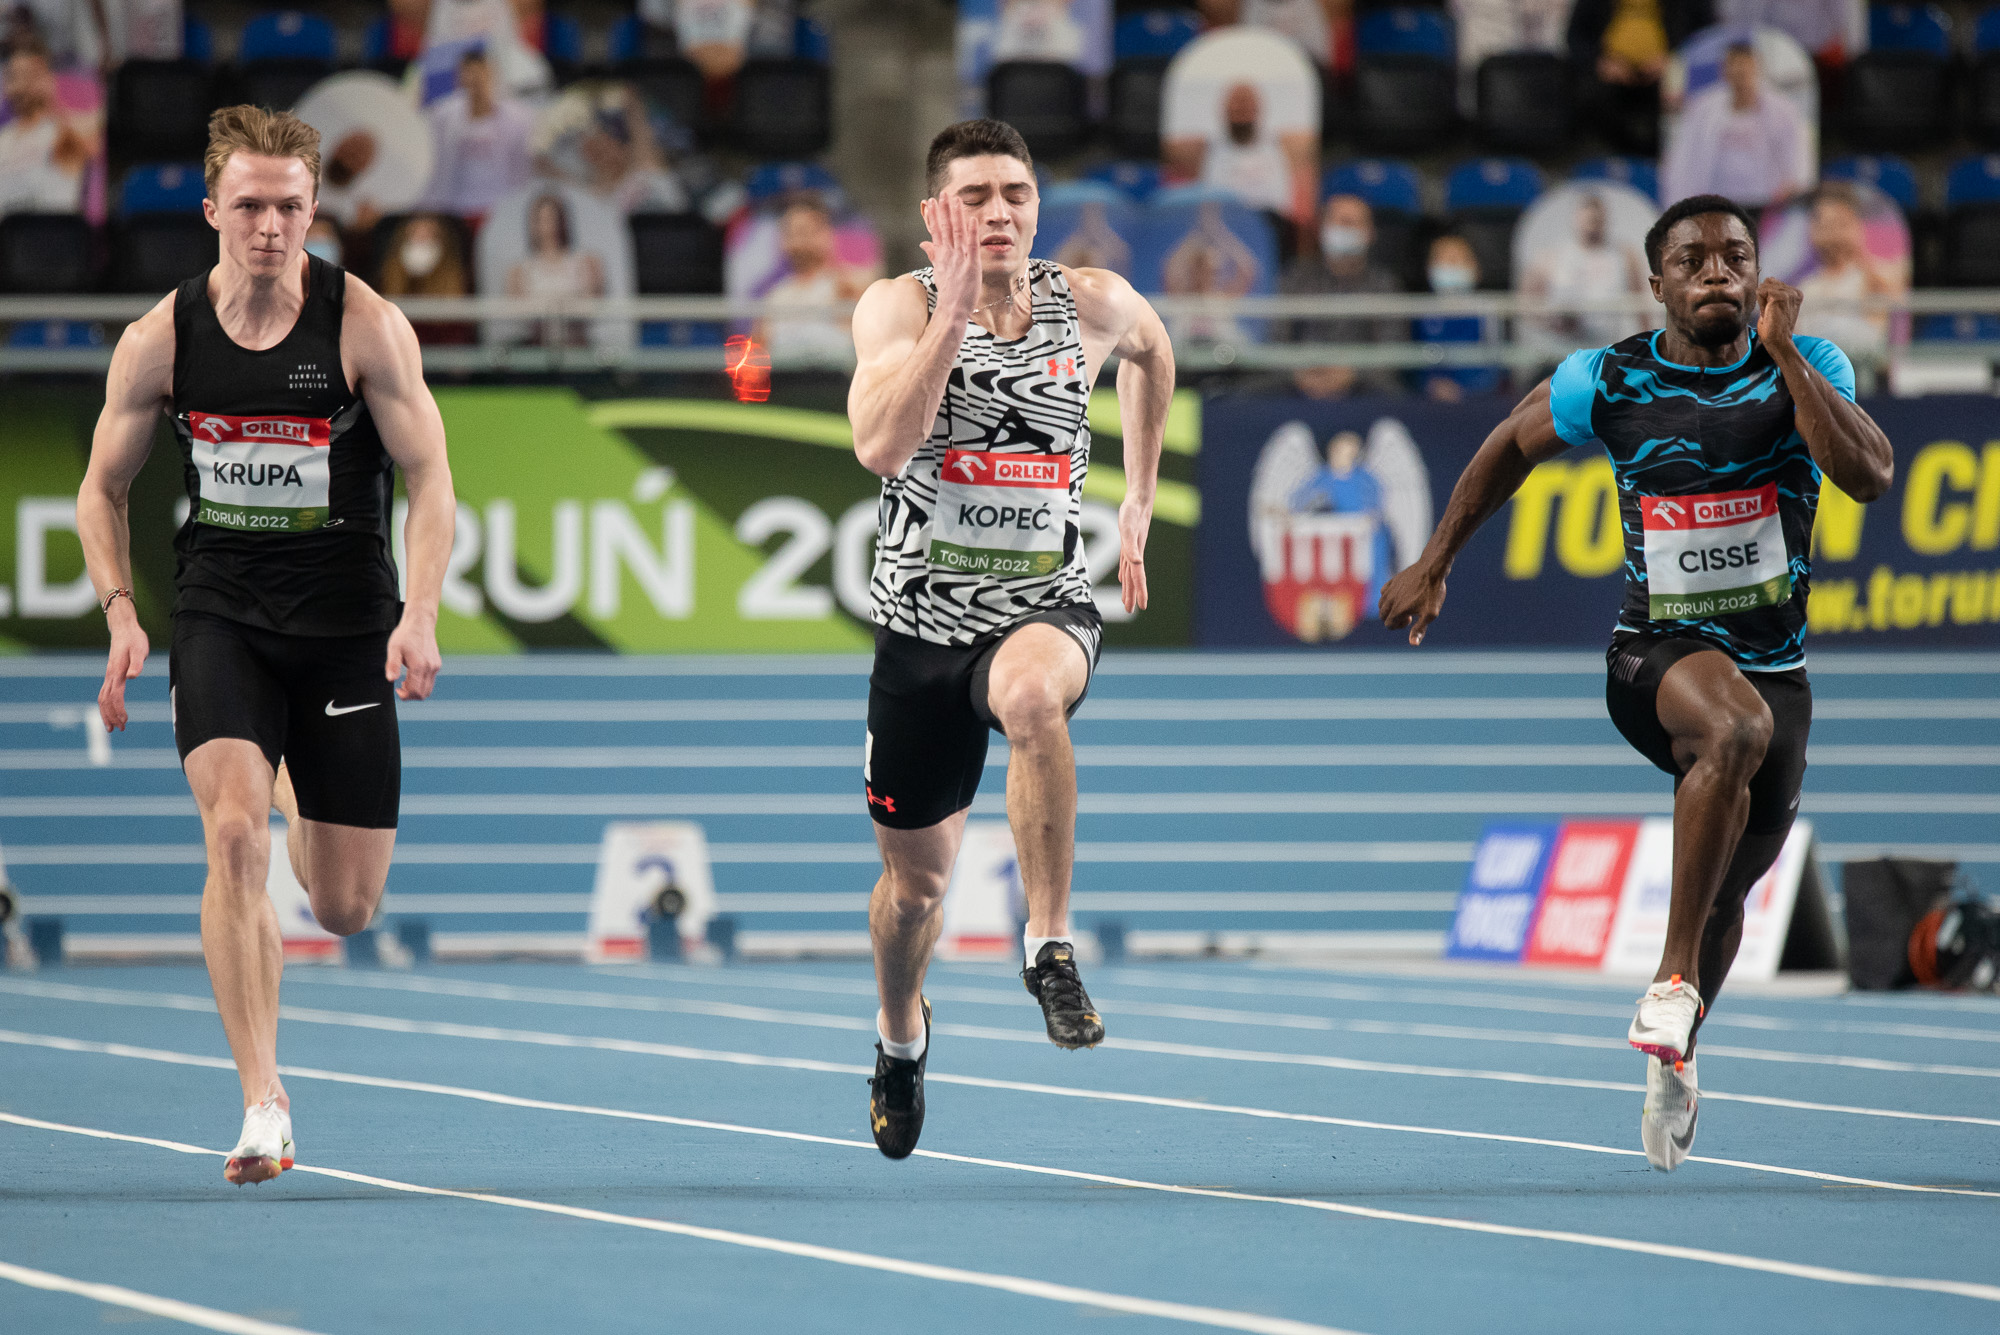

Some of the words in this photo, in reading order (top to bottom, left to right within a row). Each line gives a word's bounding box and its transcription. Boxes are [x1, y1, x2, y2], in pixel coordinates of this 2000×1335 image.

[245, 422, 305, 439] ORLEN
[213, 461, 304, 488] KRUPA
[998, 463, 1056, 480] ORLEN
[204, 507, 247, 528] TORUŃ
[249, 515, 290, 529] 2022
[957, 502, 1052, 531] KOPEĆ
[1698, 498, 1759, 520] ORLEN
[940, 549, 990, 570] TORUŃ
[992, 557, 1031, 573] 2022
[1678, 541, 1761, 574] CISSE
[1663, 596, 1715, 616] TORUŃ
[1718, 592, 1758, 611] 2022
